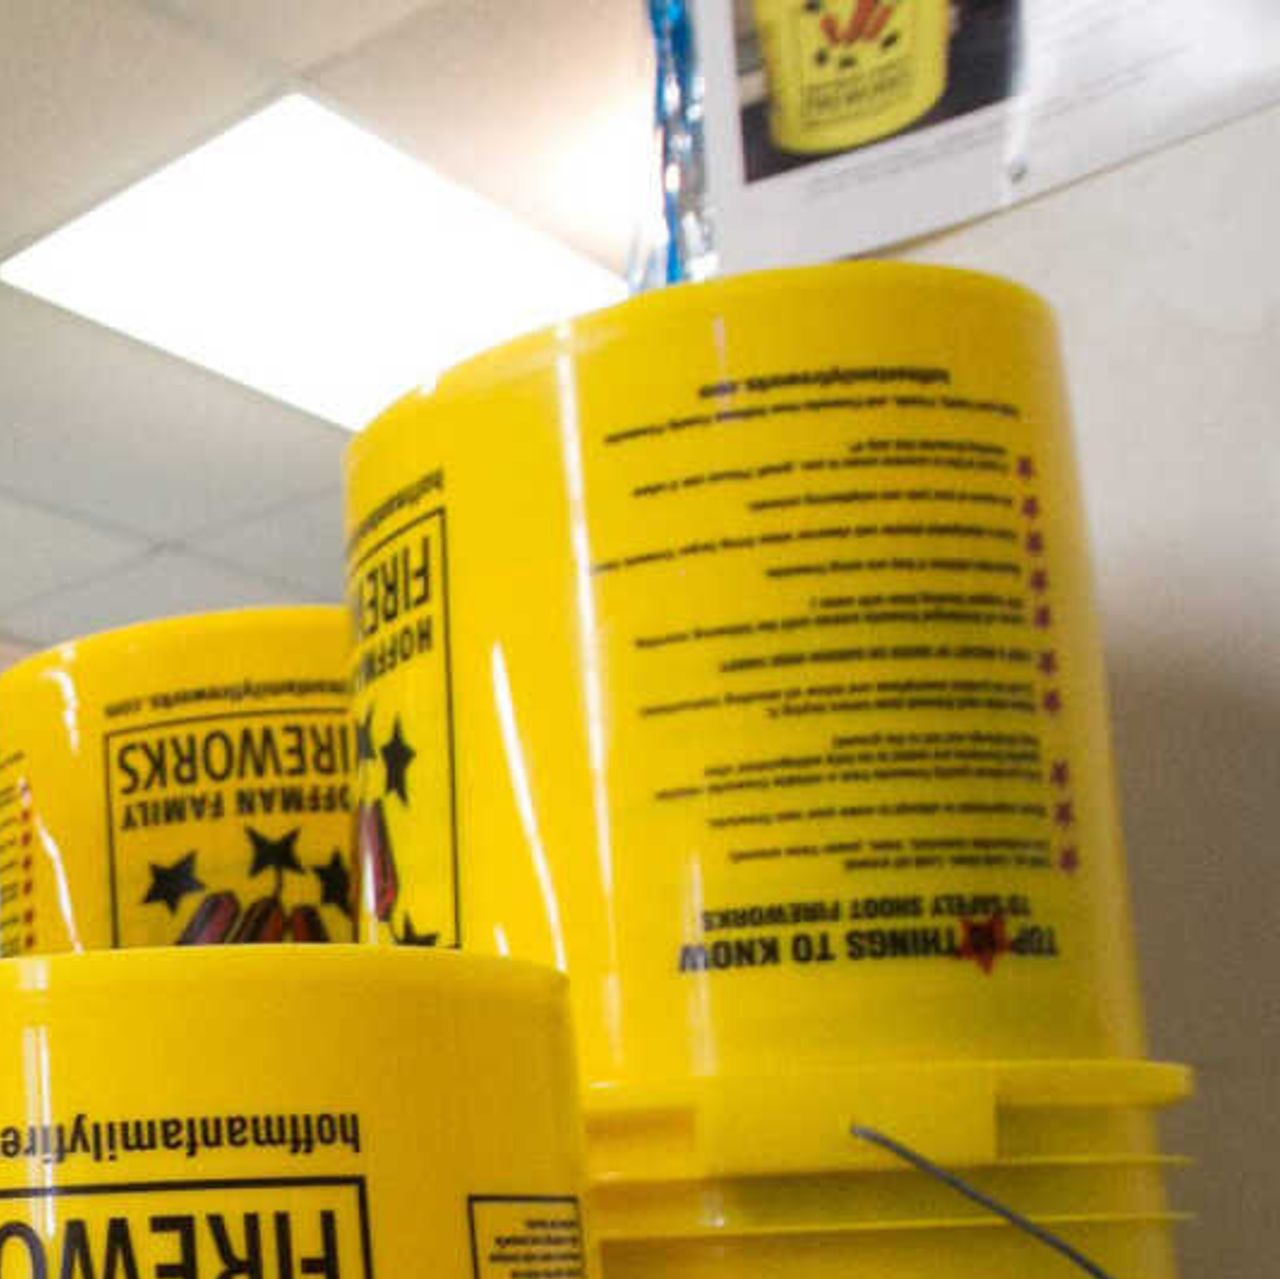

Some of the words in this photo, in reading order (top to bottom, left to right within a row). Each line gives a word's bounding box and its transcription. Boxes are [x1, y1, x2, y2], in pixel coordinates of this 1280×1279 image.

[117, 723, 350, 797] IREWORKS
[120, 791, 224, 832] FAMILY
[703, 899, 841, 932] FIREWORKS
[849, 894, 924, 919] SHOOT
[679, 936, 780, 973] KNOW
[791, 931, 836, 963] TO
[847, 925, 961, 961] THINGS
